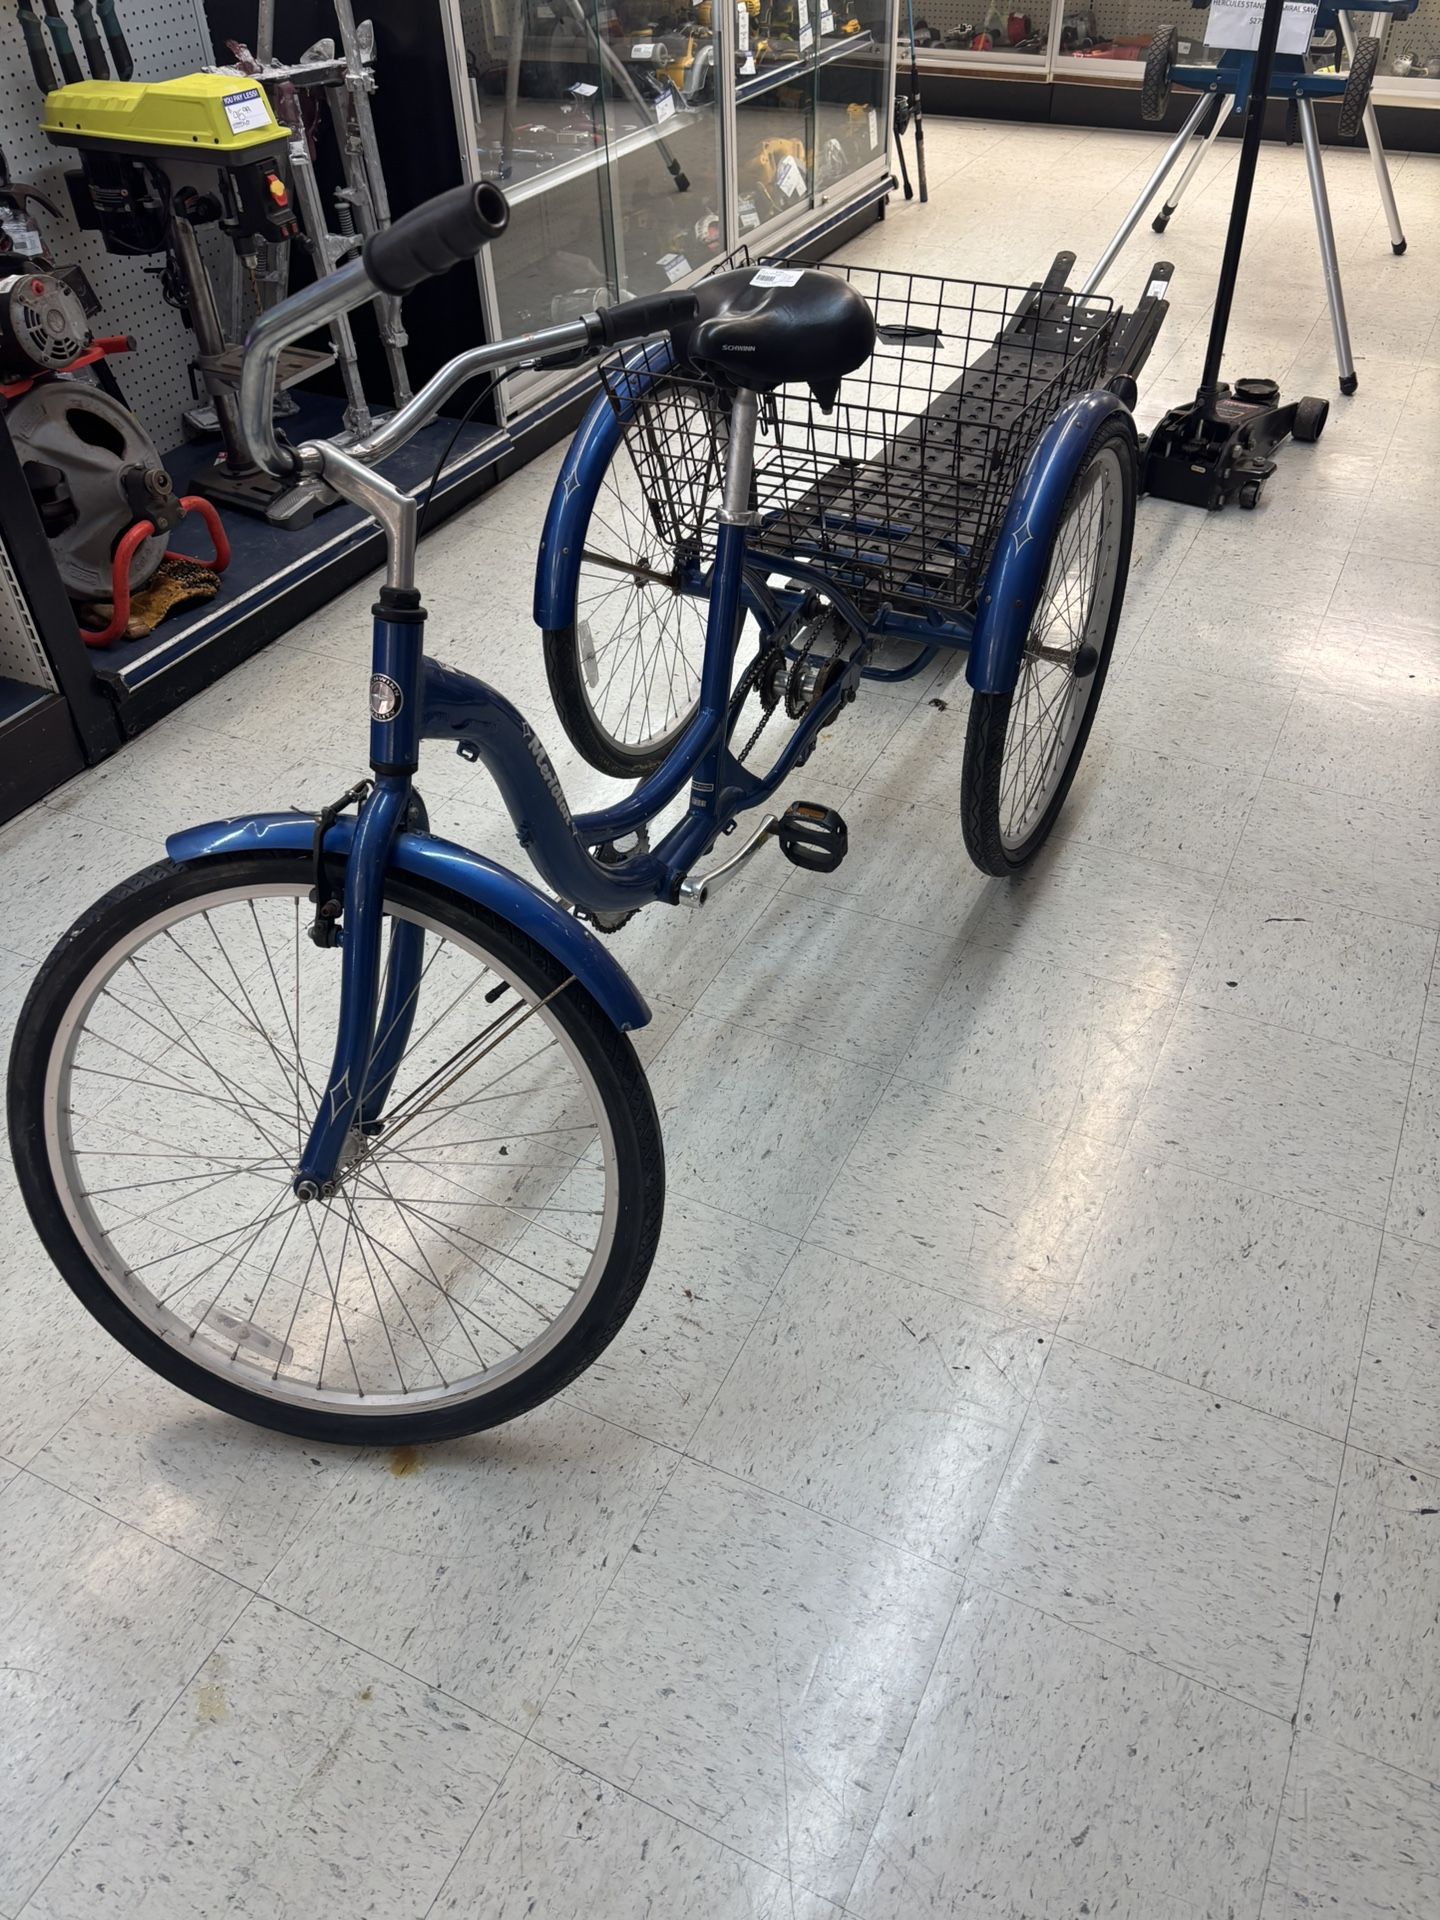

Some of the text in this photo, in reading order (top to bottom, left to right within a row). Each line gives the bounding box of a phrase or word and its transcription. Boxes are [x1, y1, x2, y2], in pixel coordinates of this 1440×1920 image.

[1302, 6, 1317, 14] SAW
[233, 94, 243, 102] PAY
[721, 344, 756, 352] SCHWINN
[527, 734, 572, 826] Meridian
